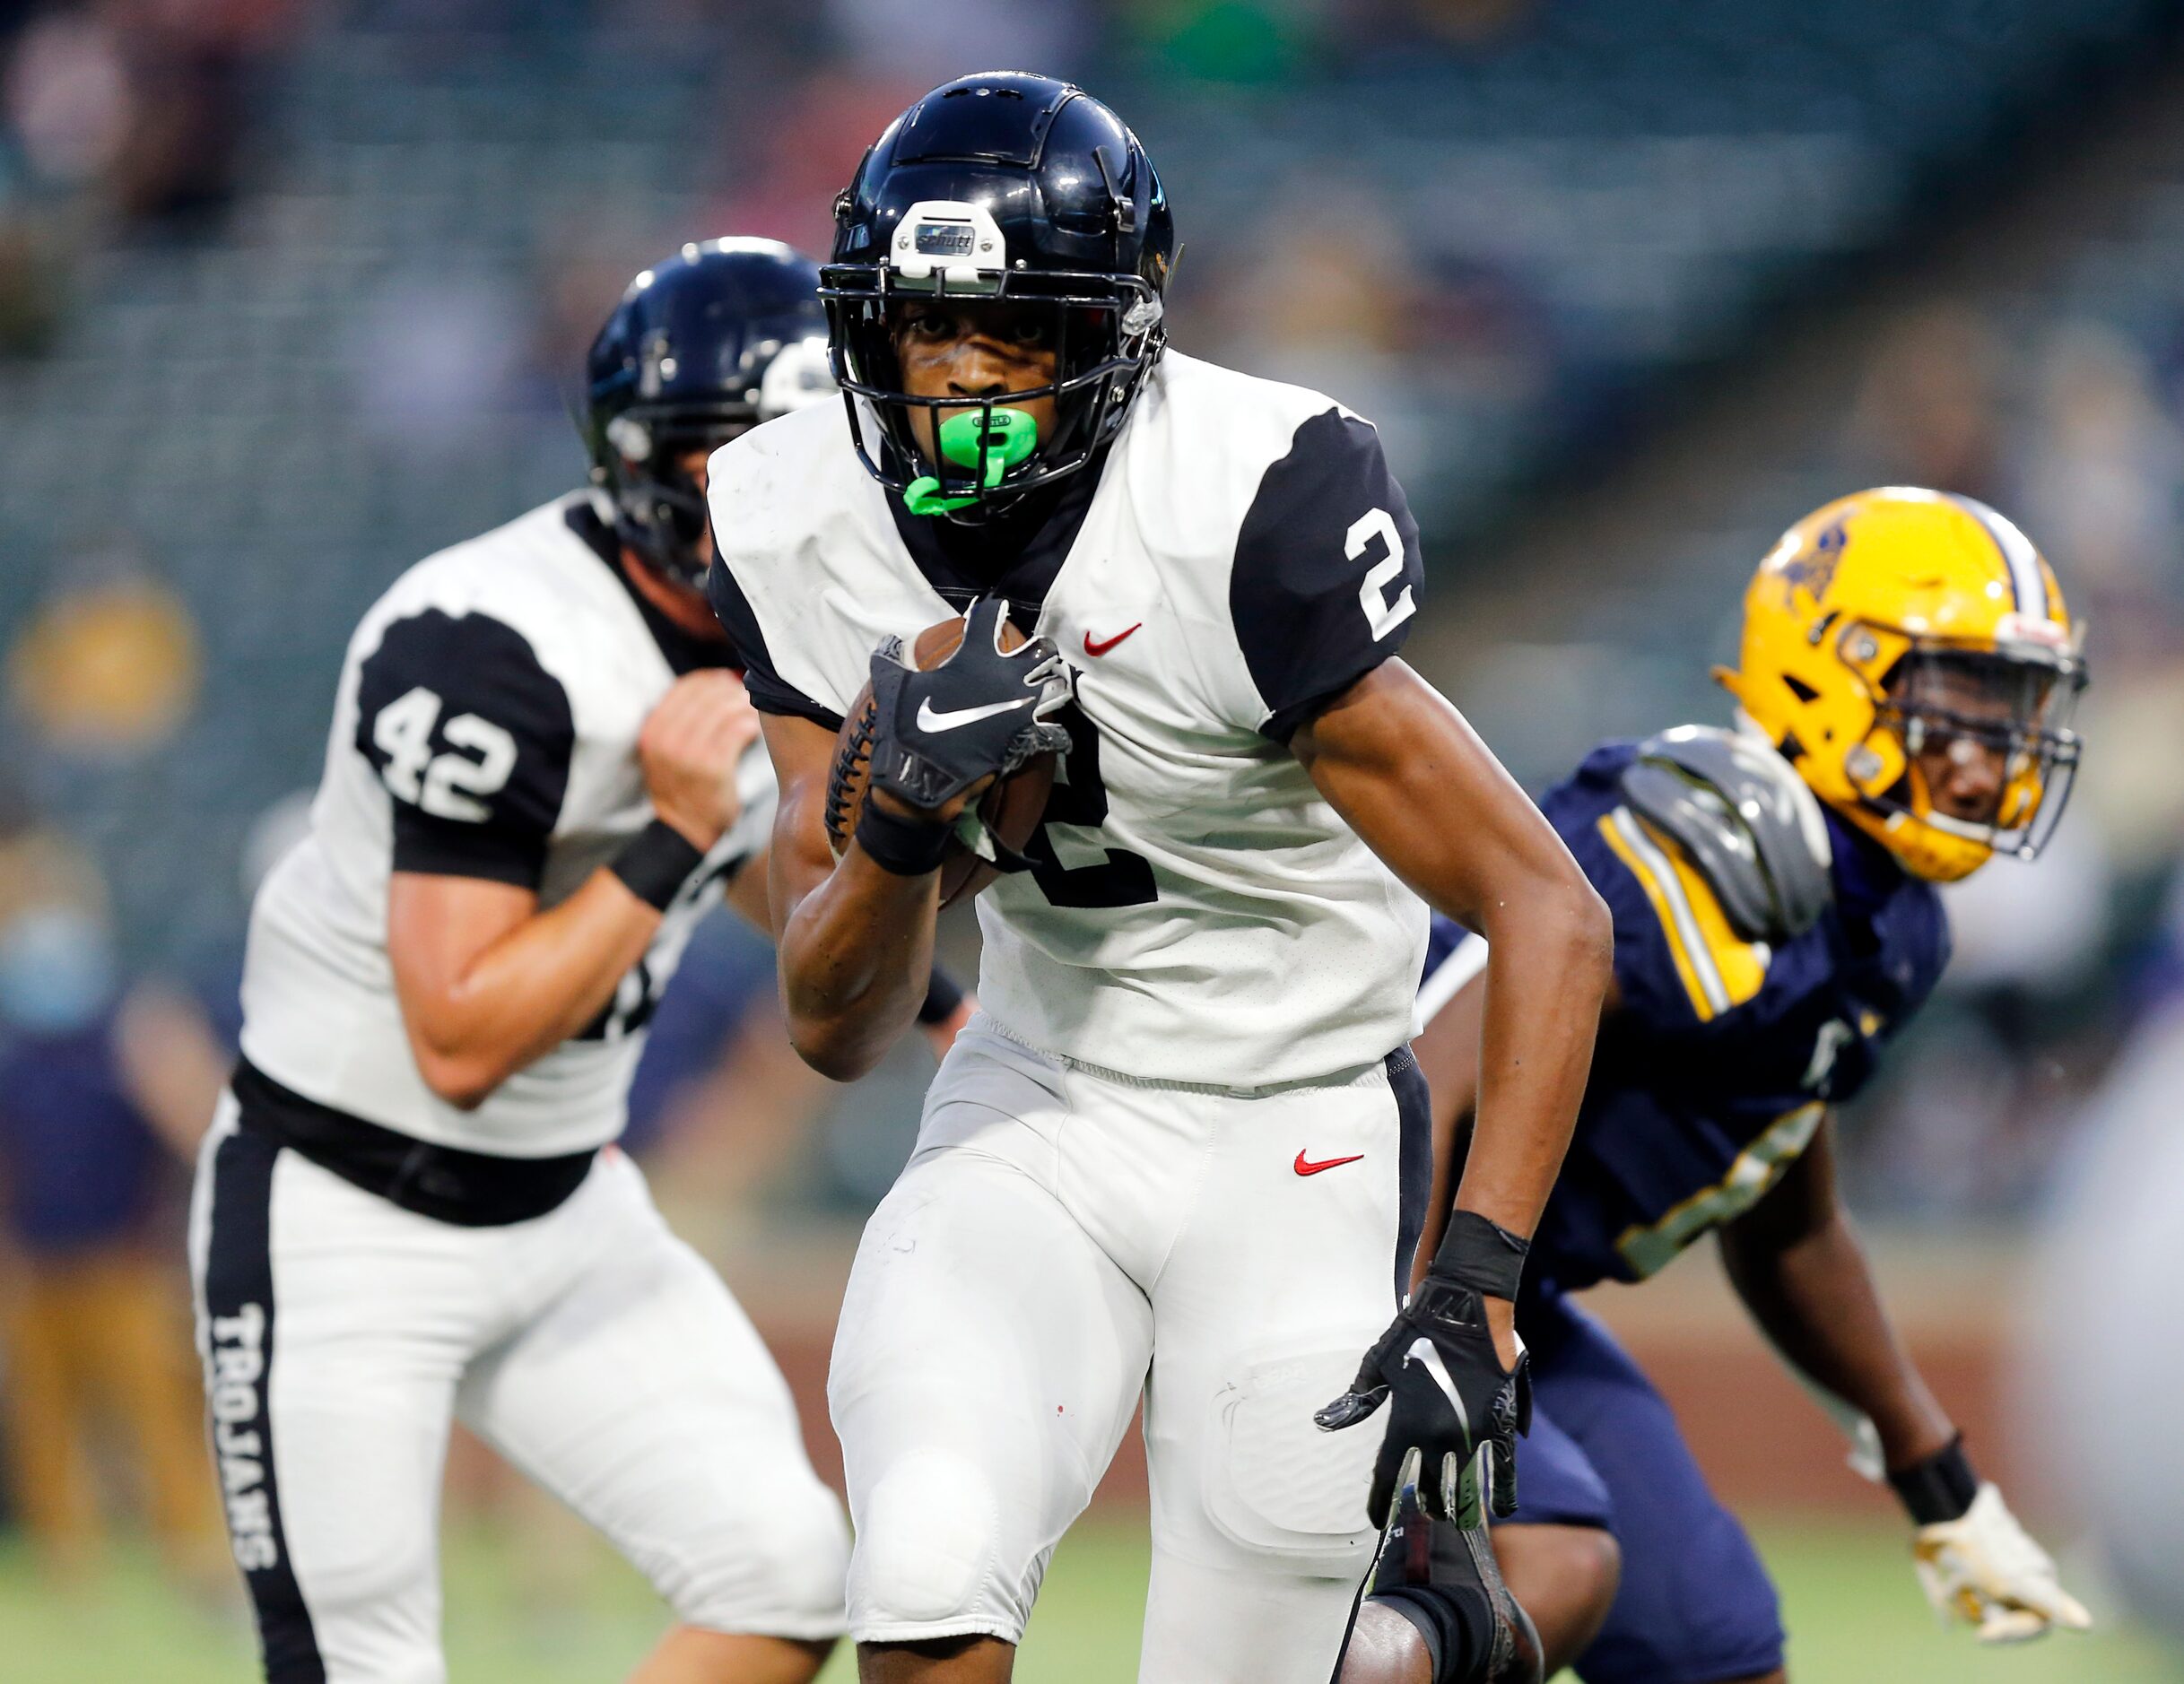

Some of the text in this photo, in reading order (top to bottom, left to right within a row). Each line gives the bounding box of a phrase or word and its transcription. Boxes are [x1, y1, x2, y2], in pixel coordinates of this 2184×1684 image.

[1344, 506, 1418, 643] 2
[373, 686, 518, 823] 42
[213, 1301, 277, 1571] TROJANS
